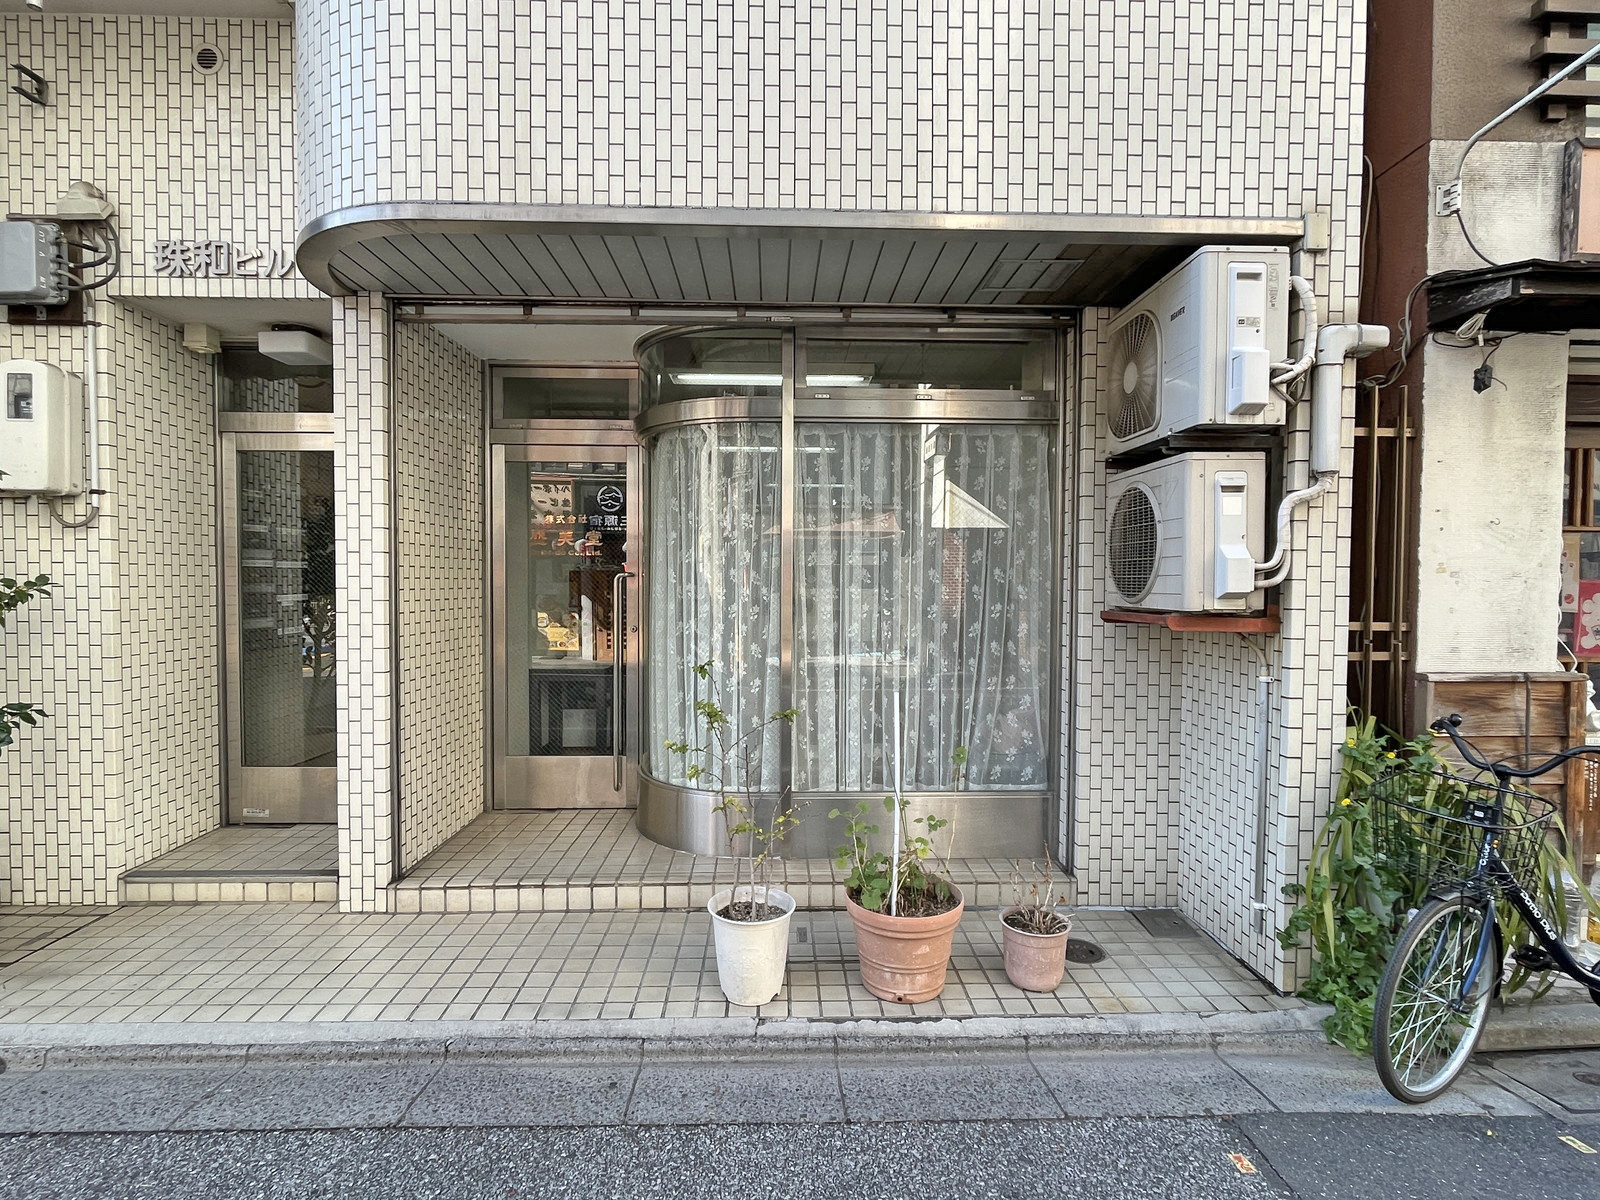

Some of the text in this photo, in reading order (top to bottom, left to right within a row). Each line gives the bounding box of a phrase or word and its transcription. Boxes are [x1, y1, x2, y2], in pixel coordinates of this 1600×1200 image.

[153, 239, 295, 278] 珠和ビル
[544, 514, 588, 525] 株式会社
